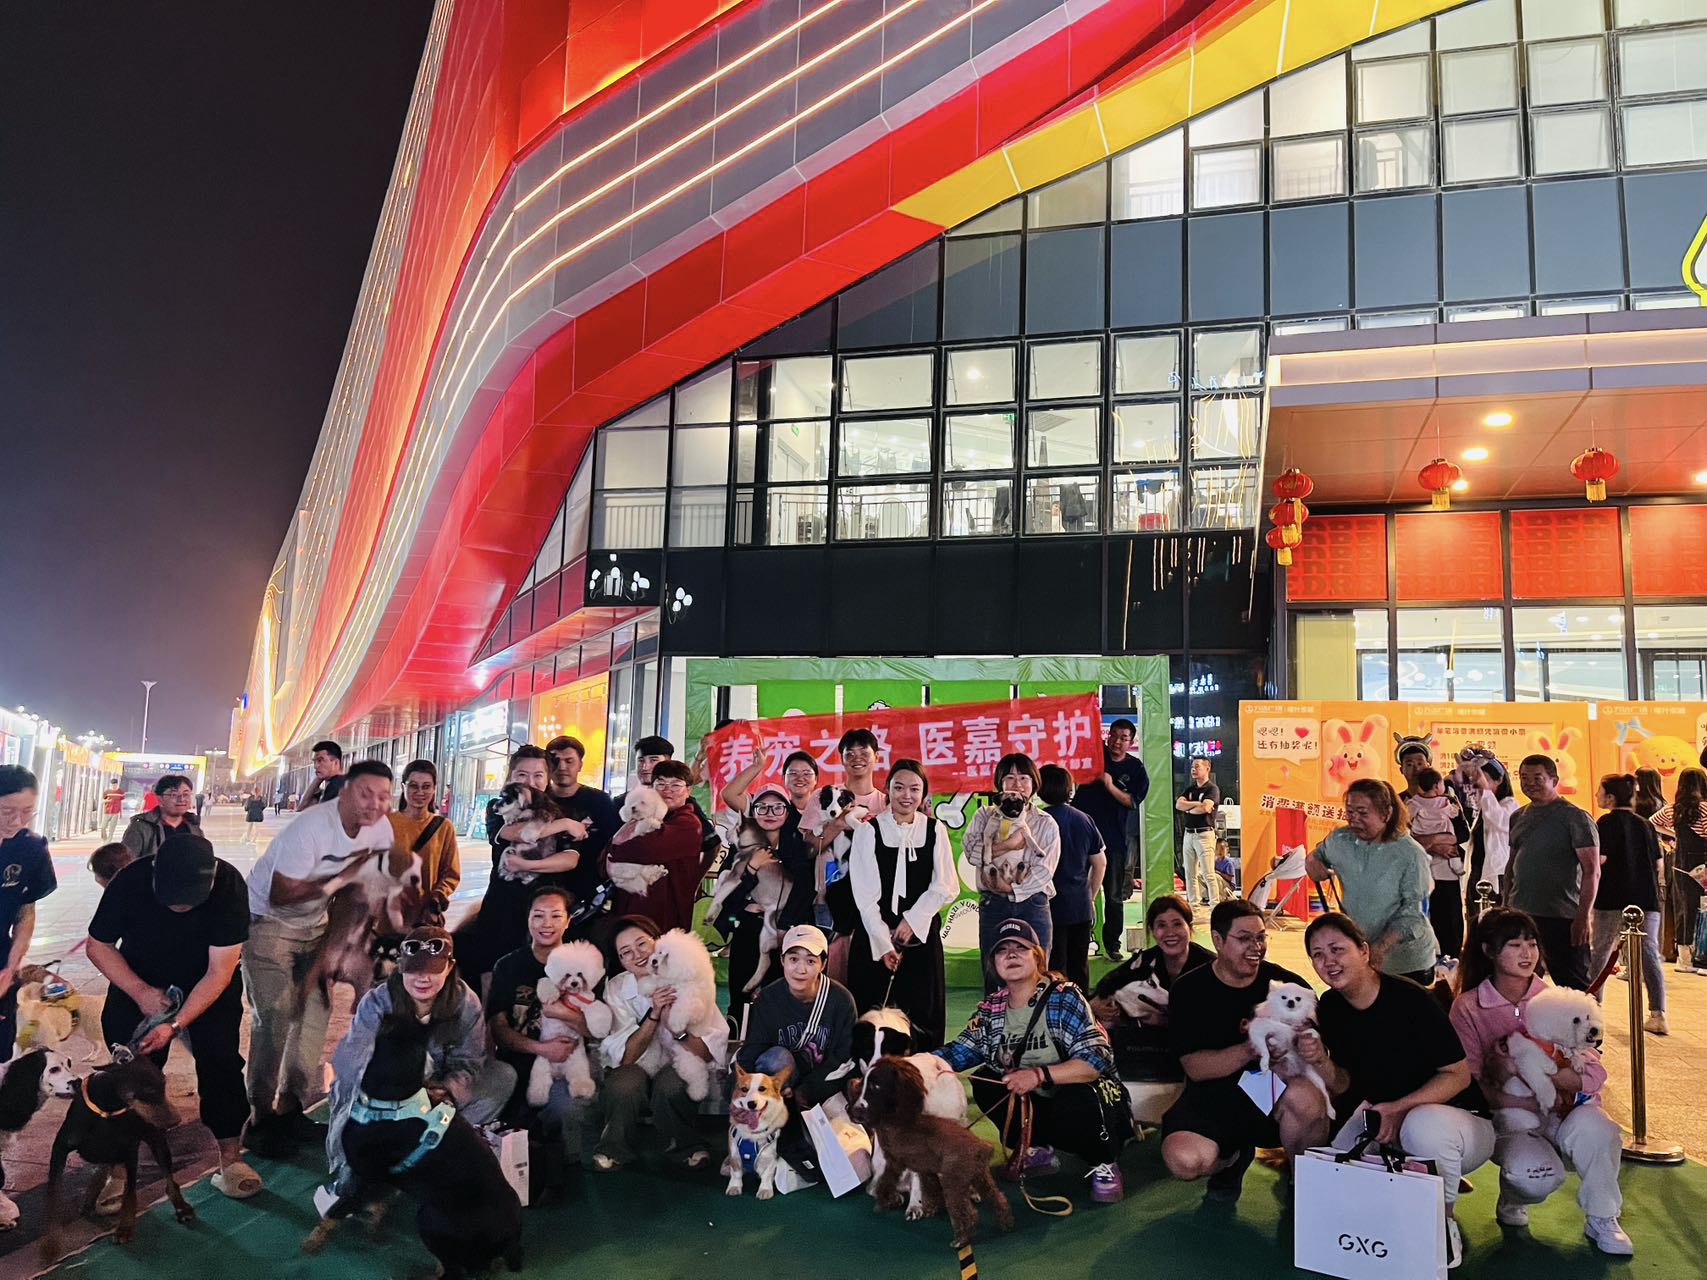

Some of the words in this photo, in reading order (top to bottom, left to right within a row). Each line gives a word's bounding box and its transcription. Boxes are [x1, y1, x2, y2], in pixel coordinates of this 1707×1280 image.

[918, 709, 1092, 766] 医嘉守护
[1338, 1233, 1388, 1258] GXG
